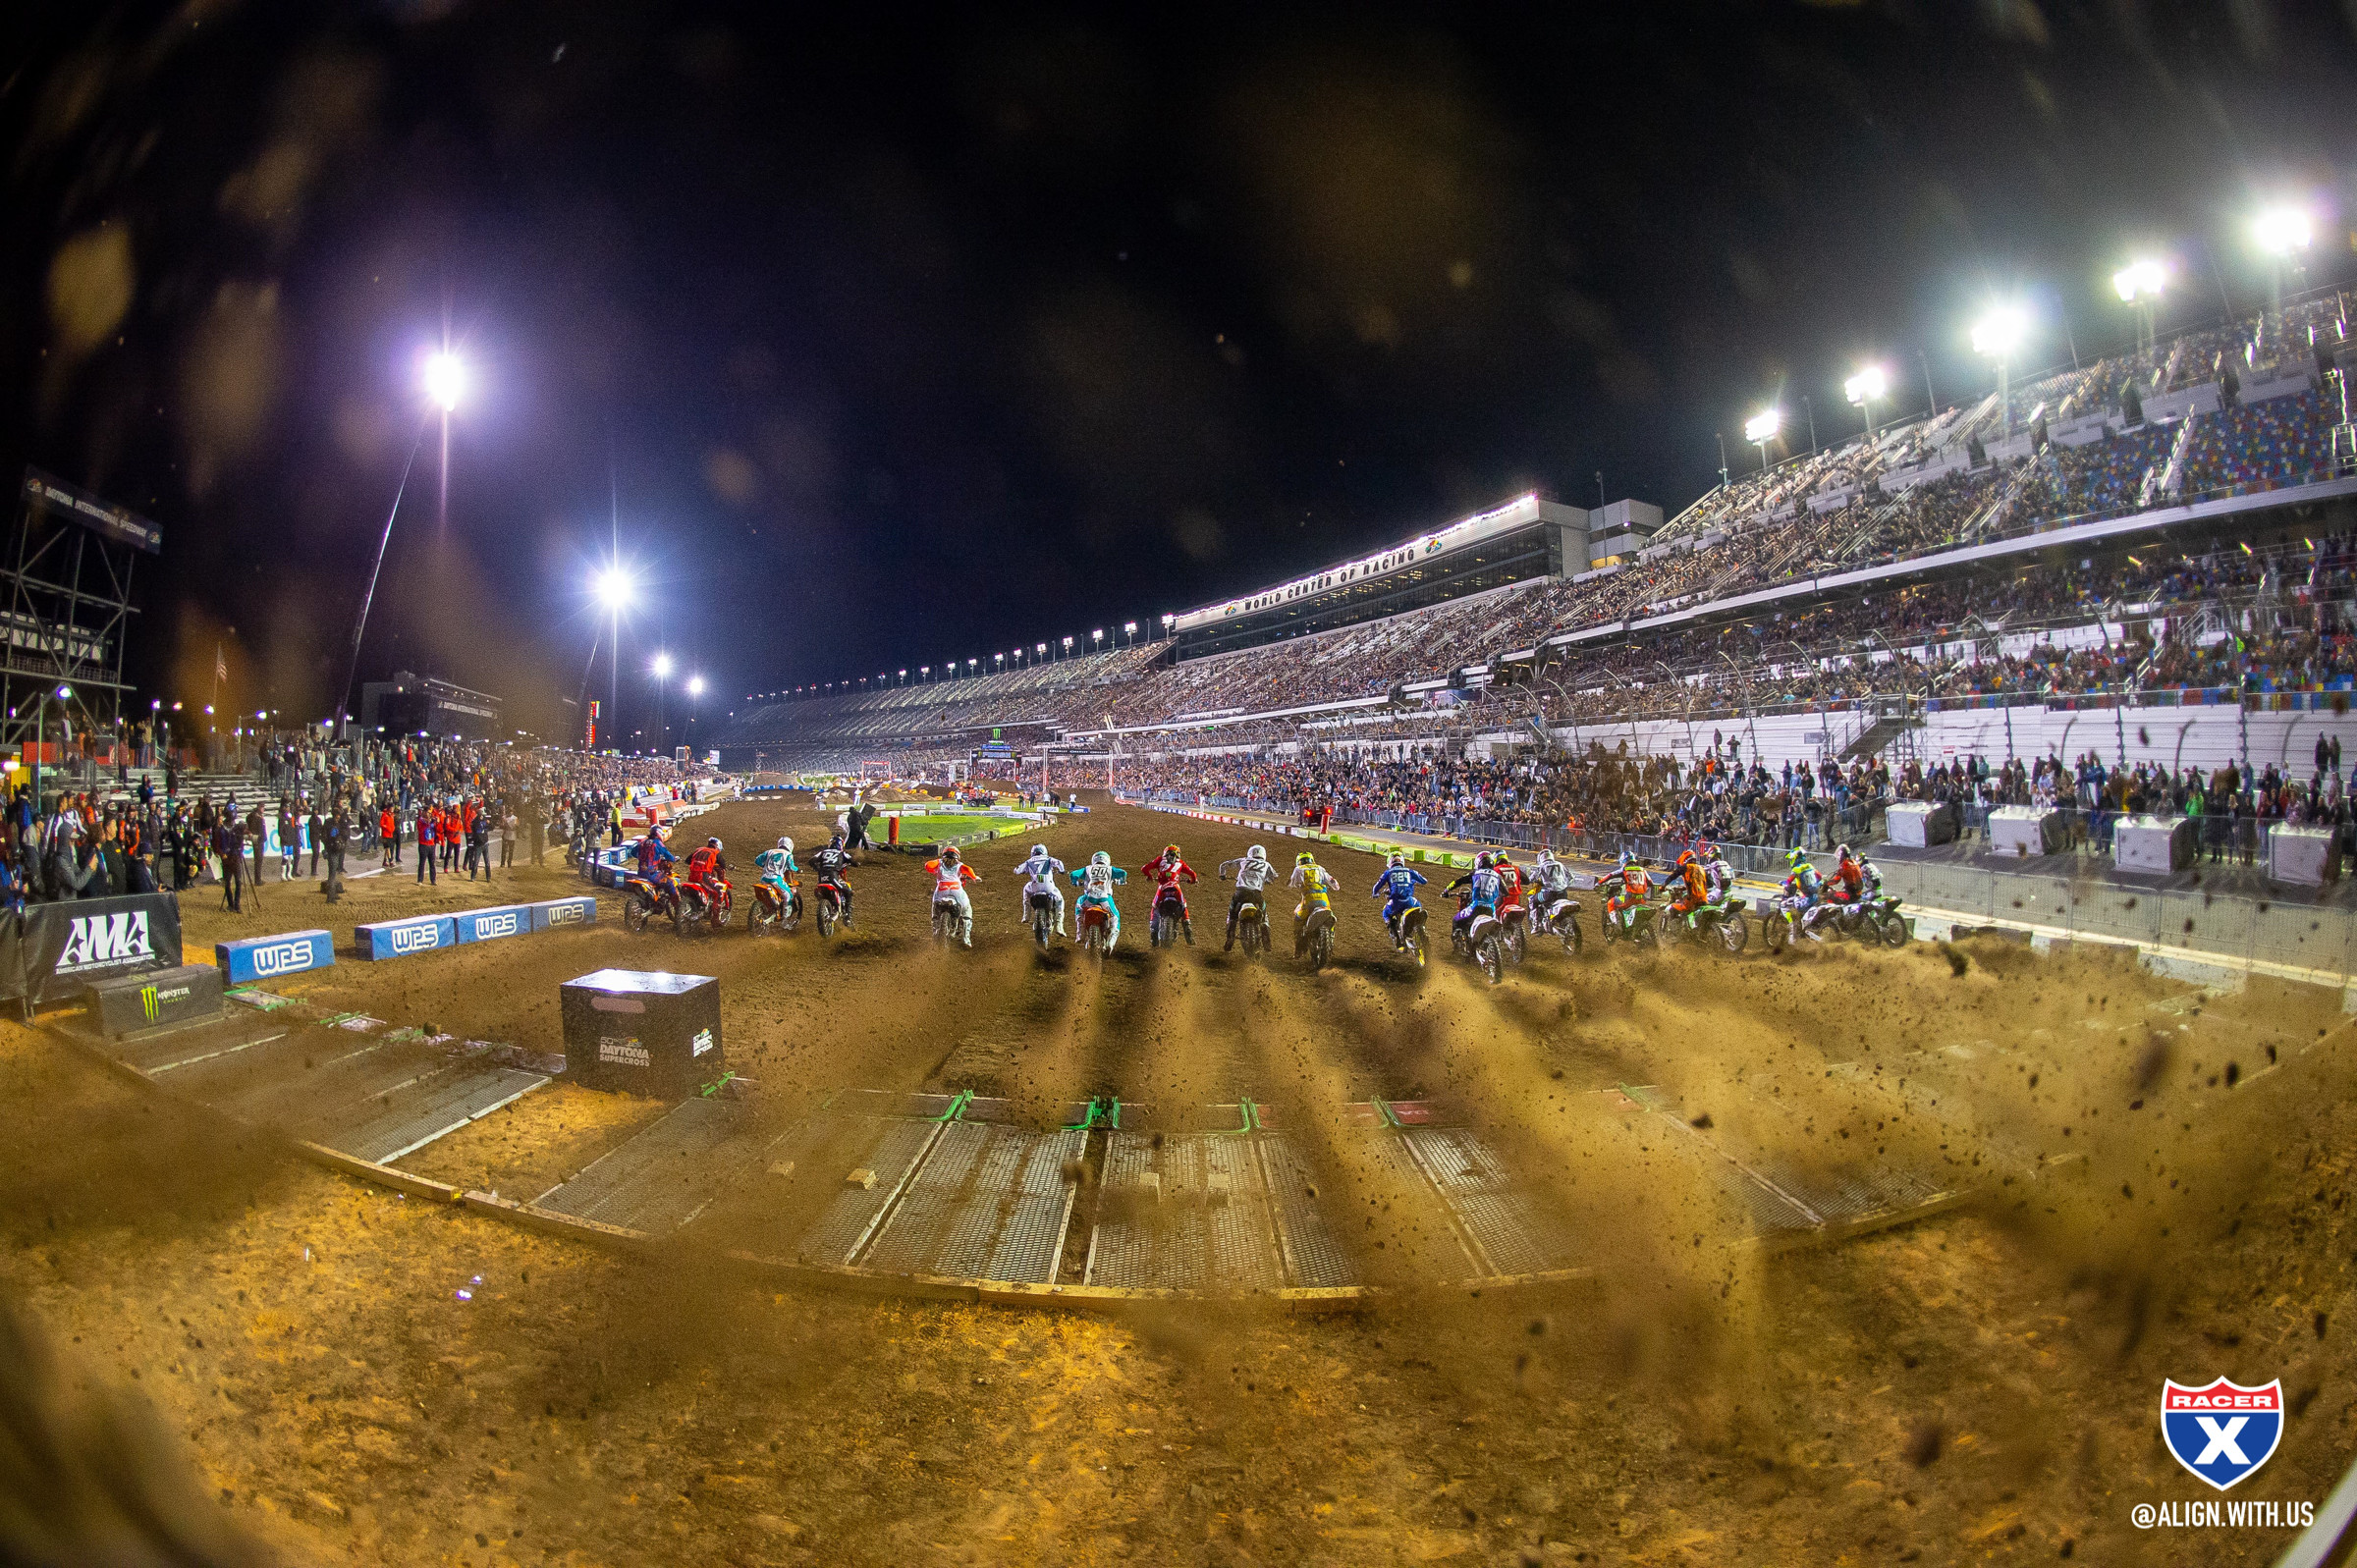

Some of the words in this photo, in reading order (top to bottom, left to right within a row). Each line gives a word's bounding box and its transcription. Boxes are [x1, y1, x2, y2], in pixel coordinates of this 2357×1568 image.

[46, 486, 74, 508] DAYTONA
[75, 499, 119, 527] INTERNATIONAL
[120, 518, 147, 538] SPEEDWAY
[1244, 593, 1281, 611] WORLD
[1288, 575, 1332, 599] CENTER
[1340, 568, 1355, 583] OF
[1363, 549, 1414, 575] RACING
[1244, 859, 1266, 873] 722
[475, 913, 517, 940] WPS
[548, 902, 584, 927] WPS
[55, 910, 155, 966] AMA
[392, 923, 439, 952] WPS
[253, 940, 313, 976] WPS
[157, 987, 191, 1000] MONSTER
[599, 1044, 650, 1059] DAYTONA
[599, 1054, 650, 1067] SUPERCROSS
